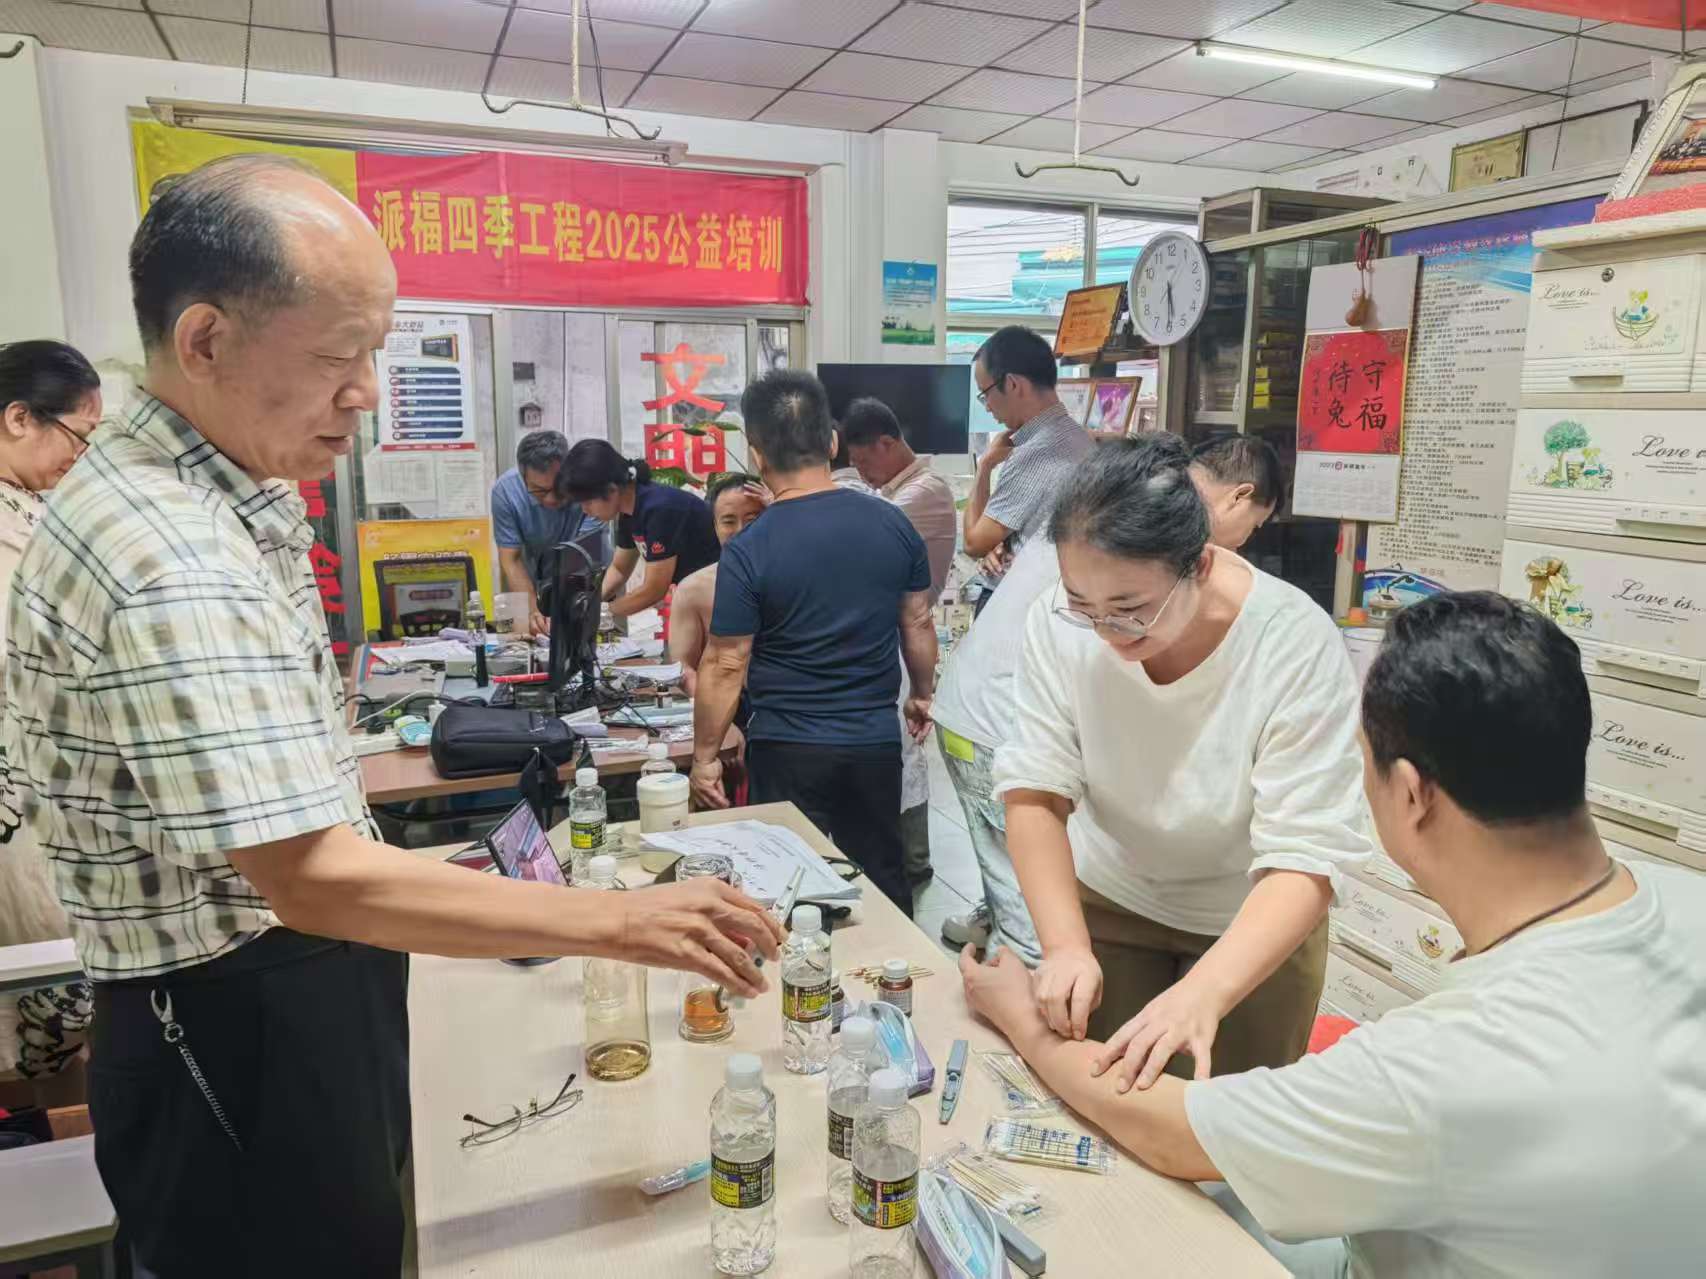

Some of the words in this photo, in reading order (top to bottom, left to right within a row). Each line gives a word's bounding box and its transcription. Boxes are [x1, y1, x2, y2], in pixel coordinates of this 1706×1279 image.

[374, 190, 783, 273] 派福四季工程2025公益培训
[1167, 243, 1177, 257] 12
[1145, 268, 1155, 280] 10
[1192, 261, 1199, 274] 2
[1194, 280, 1201, 292] 3
[1540, 282, 1577, 300] Love
[1143, 304, 1150, 316] 8
[1190, 300, 1197, 312] 4
[1154, 317, 1160, 328] 7
[1632, 434, 1690, 458] Love
[1612, 579, 1670, 607] Love
[1594, 719, 1648, 751] Love
[1653, 743, 1686, 761] is...
